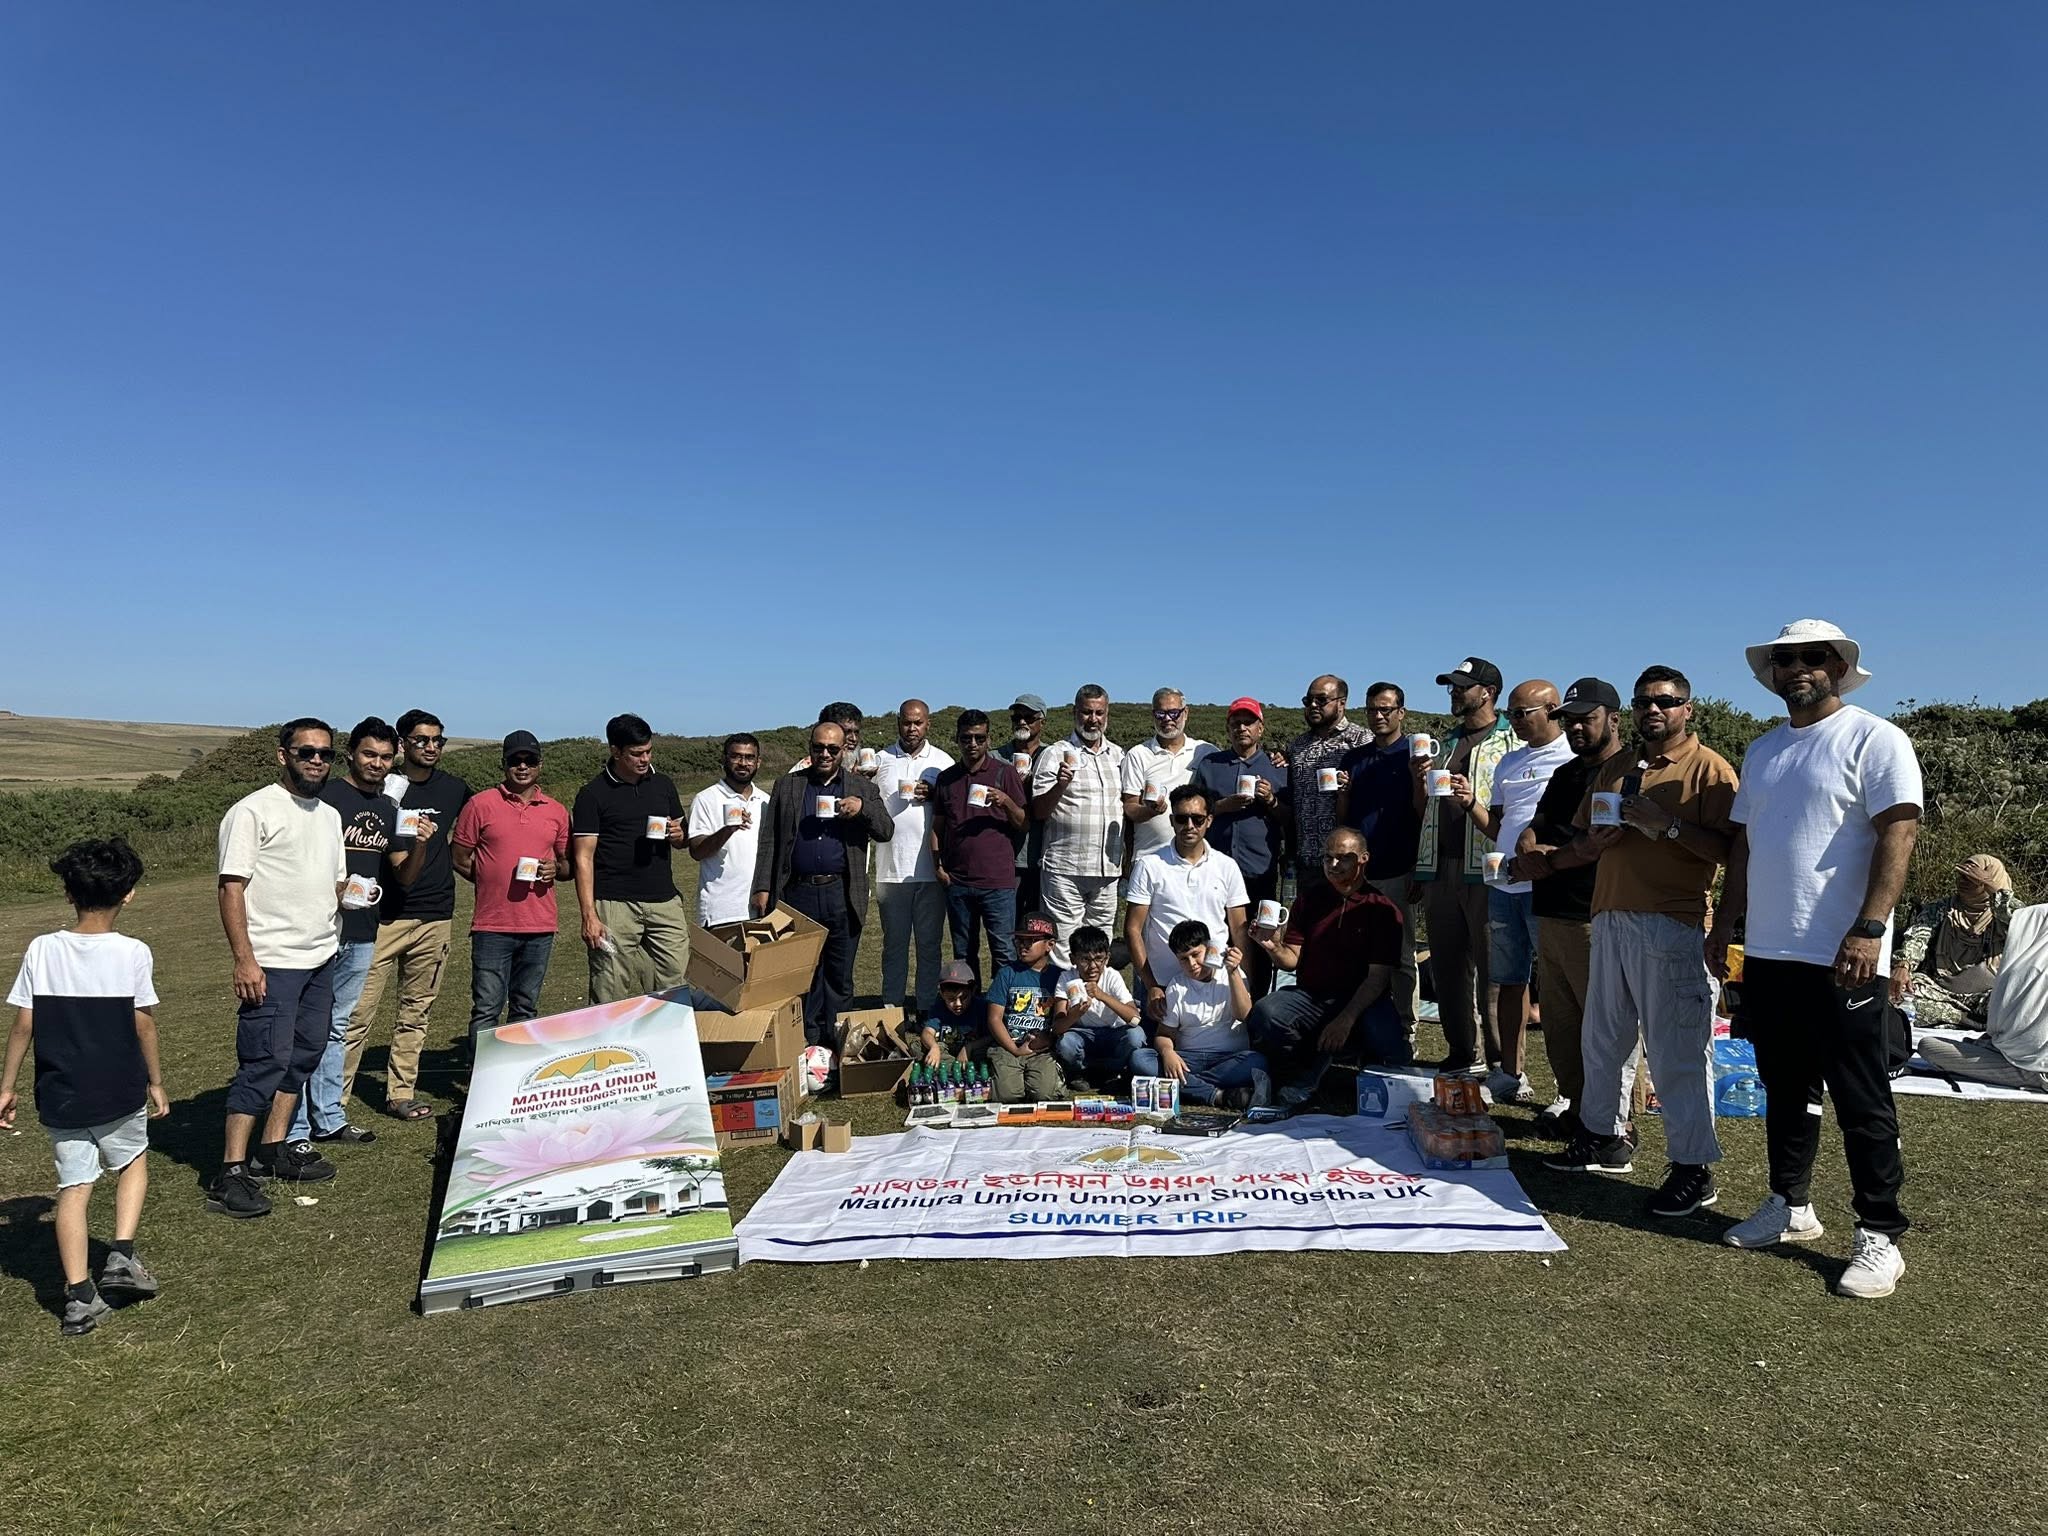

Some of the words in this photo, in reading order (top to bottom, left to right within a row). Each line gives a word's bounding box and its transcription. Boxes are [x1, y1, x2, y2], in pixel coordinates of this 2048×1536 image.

[510, 1099, 567, 1115] UNNOYAN
[570, 1085, 640, 1105] SHONGSTHA
[642, 1081, 659, 1092] UK
[512, 1082, 601, 1106] MATHIURA
[606, 1071, 657, 1089] UNION
[838, 1194, 962, 1210] Mathiura
[974, 1189, 1057, 1205] Union
[1070, 1189, 1200, 1207] Unnoyan
[1210, 1186, 1376, 1204] Shongstha
[1385, 1185, 1434, 1199] UK
[1007, 1211, 1160, 1225] SUMMER
[1175, 1210, 1248, 1225] TRIP
